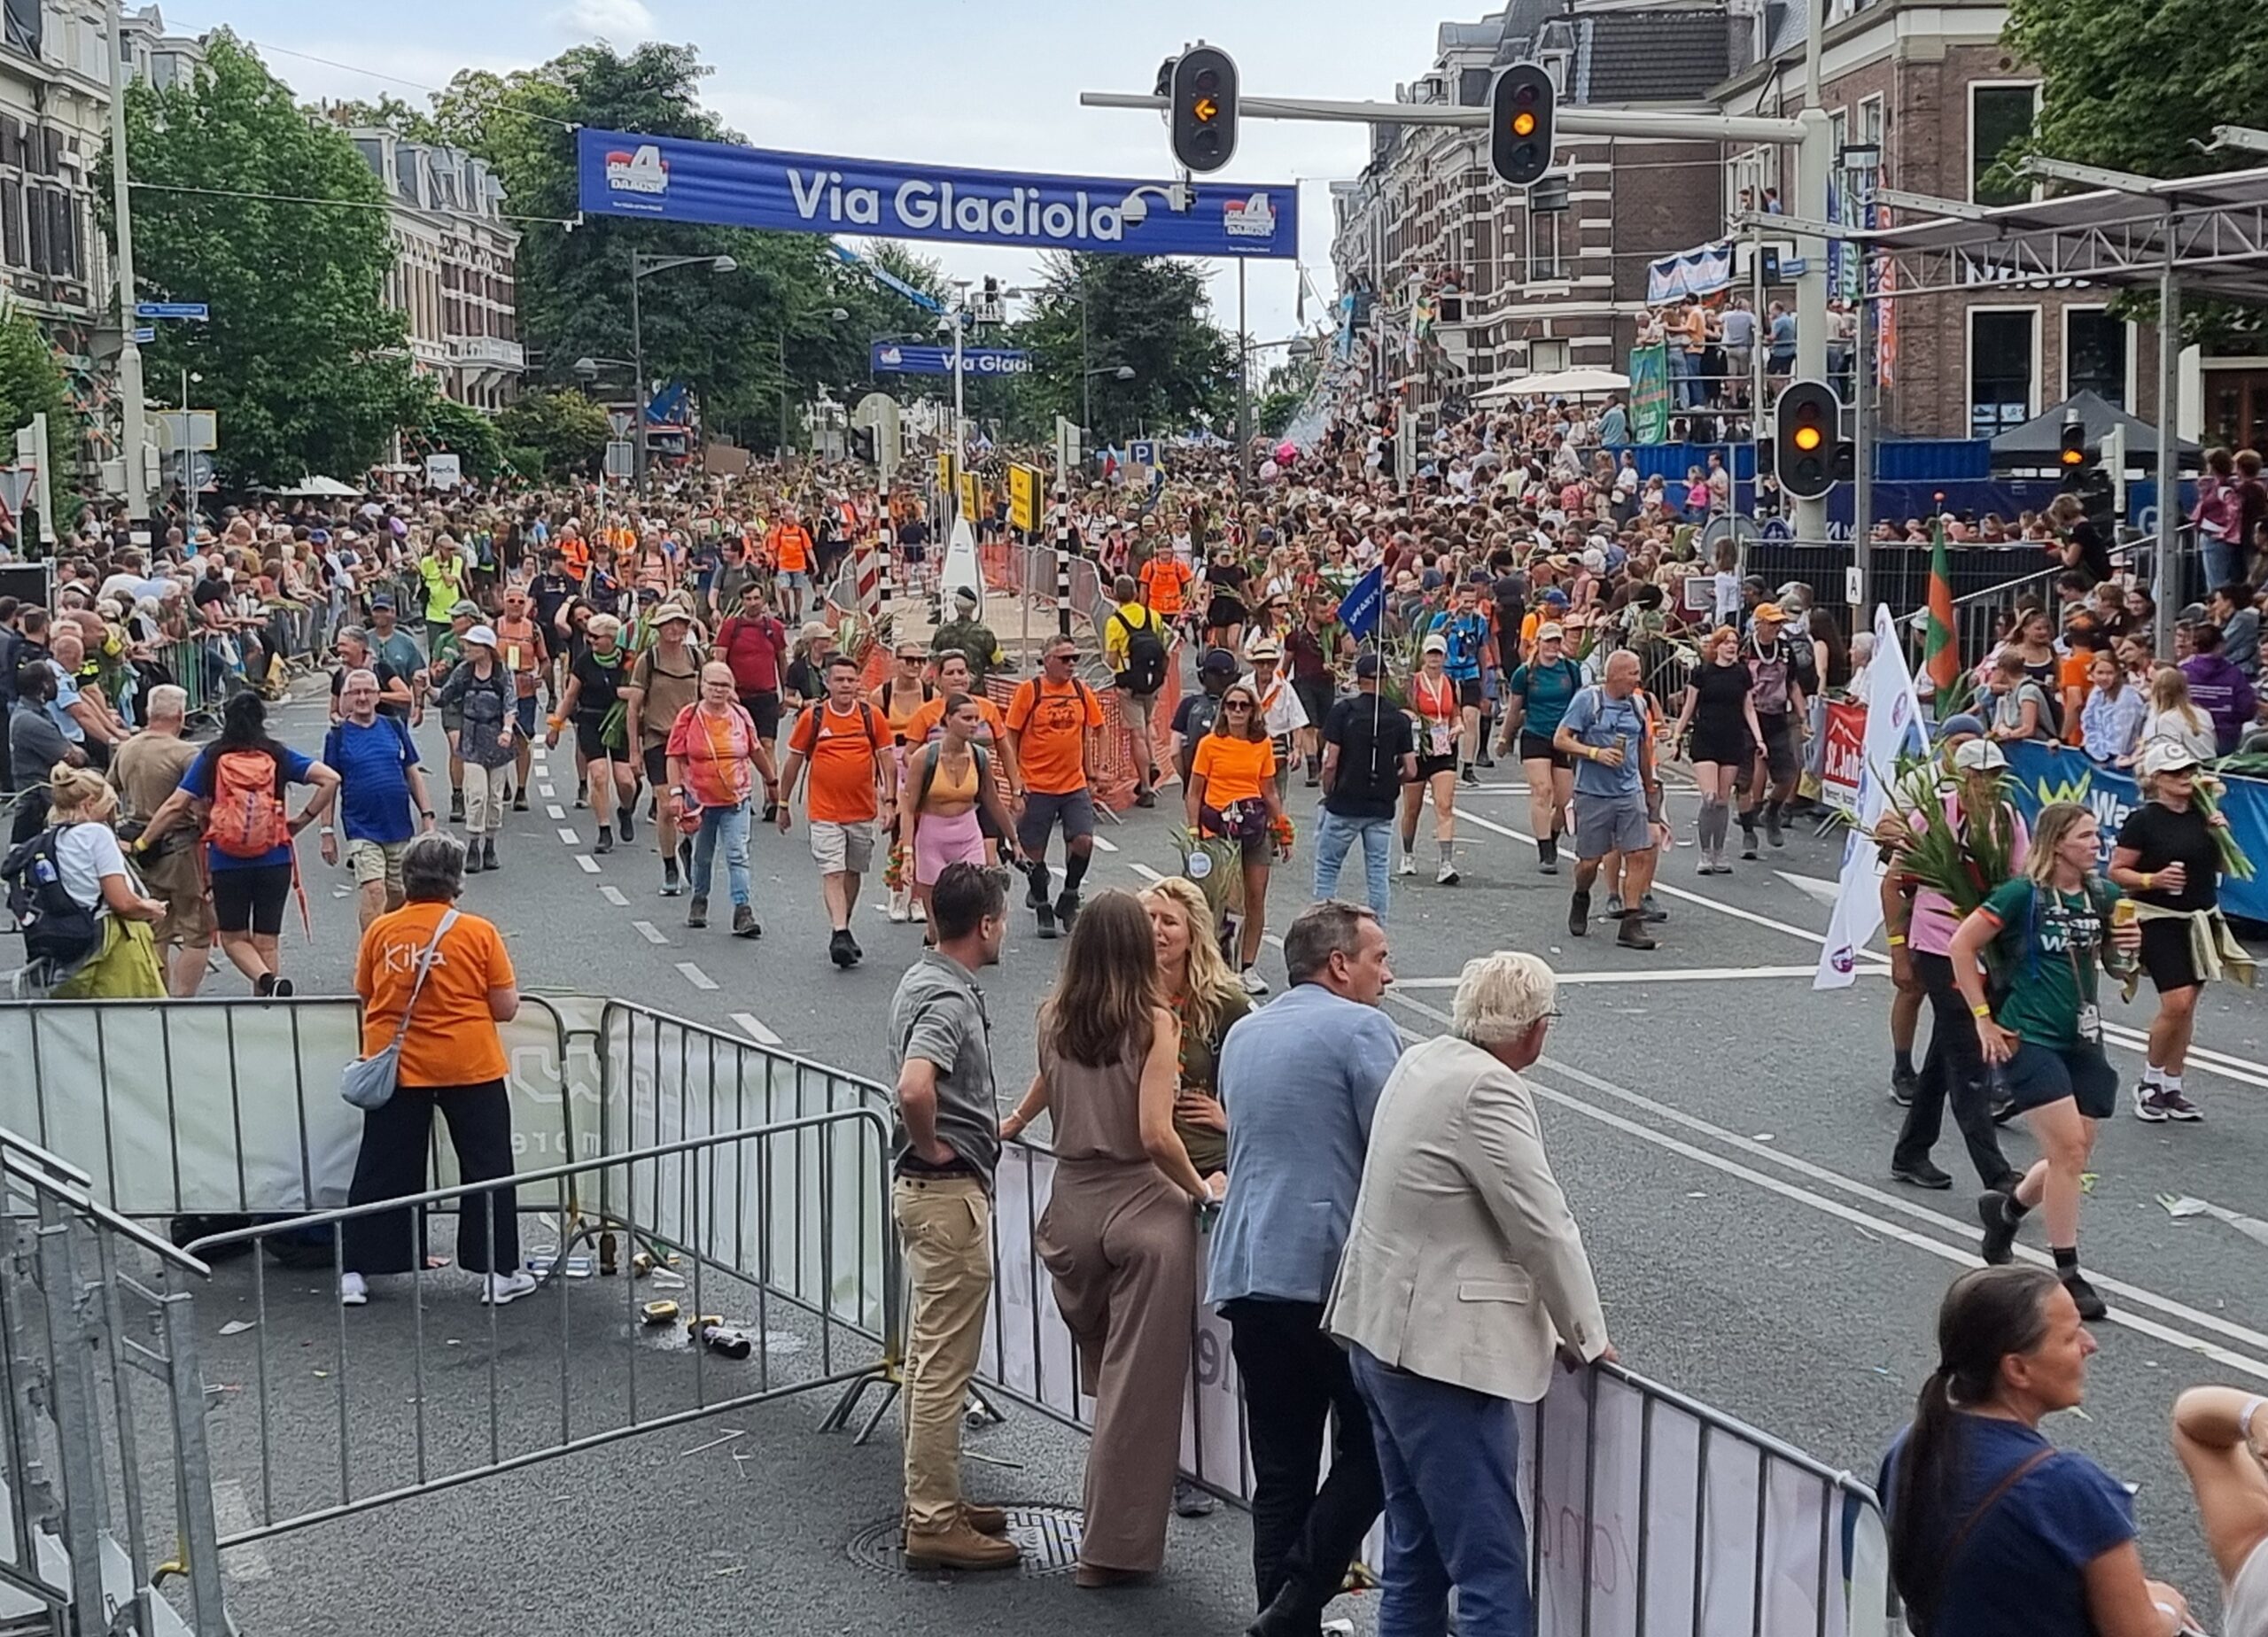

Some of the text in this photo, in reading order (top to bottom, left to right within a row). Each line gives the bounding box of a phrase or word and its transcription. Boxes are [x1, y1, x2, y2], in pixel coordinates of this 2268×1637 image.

[787, 168, 1123, 241] Via Gladiola
[942, 353, 974, 371] Va
[1850, 575, 1859, 595] A
